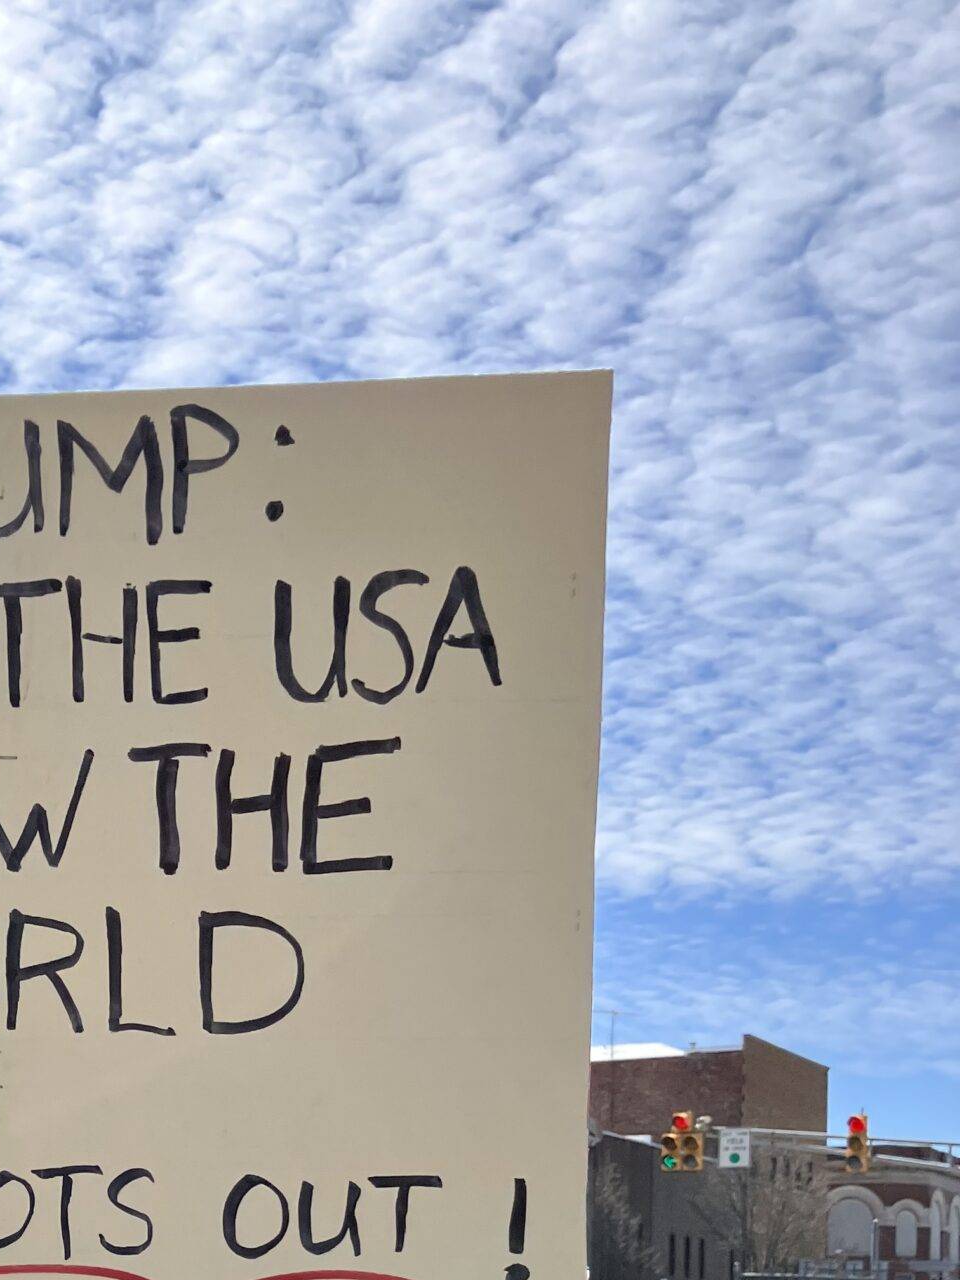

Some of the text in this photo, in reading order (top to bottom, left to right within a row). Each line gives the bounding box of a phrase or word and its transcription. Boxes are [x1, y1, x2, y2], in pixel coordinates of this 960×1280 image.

[274, 566, 502, 705] USA
[128, 737, 401, 875] THE
[223, 1174, 442, 1259] OUT
